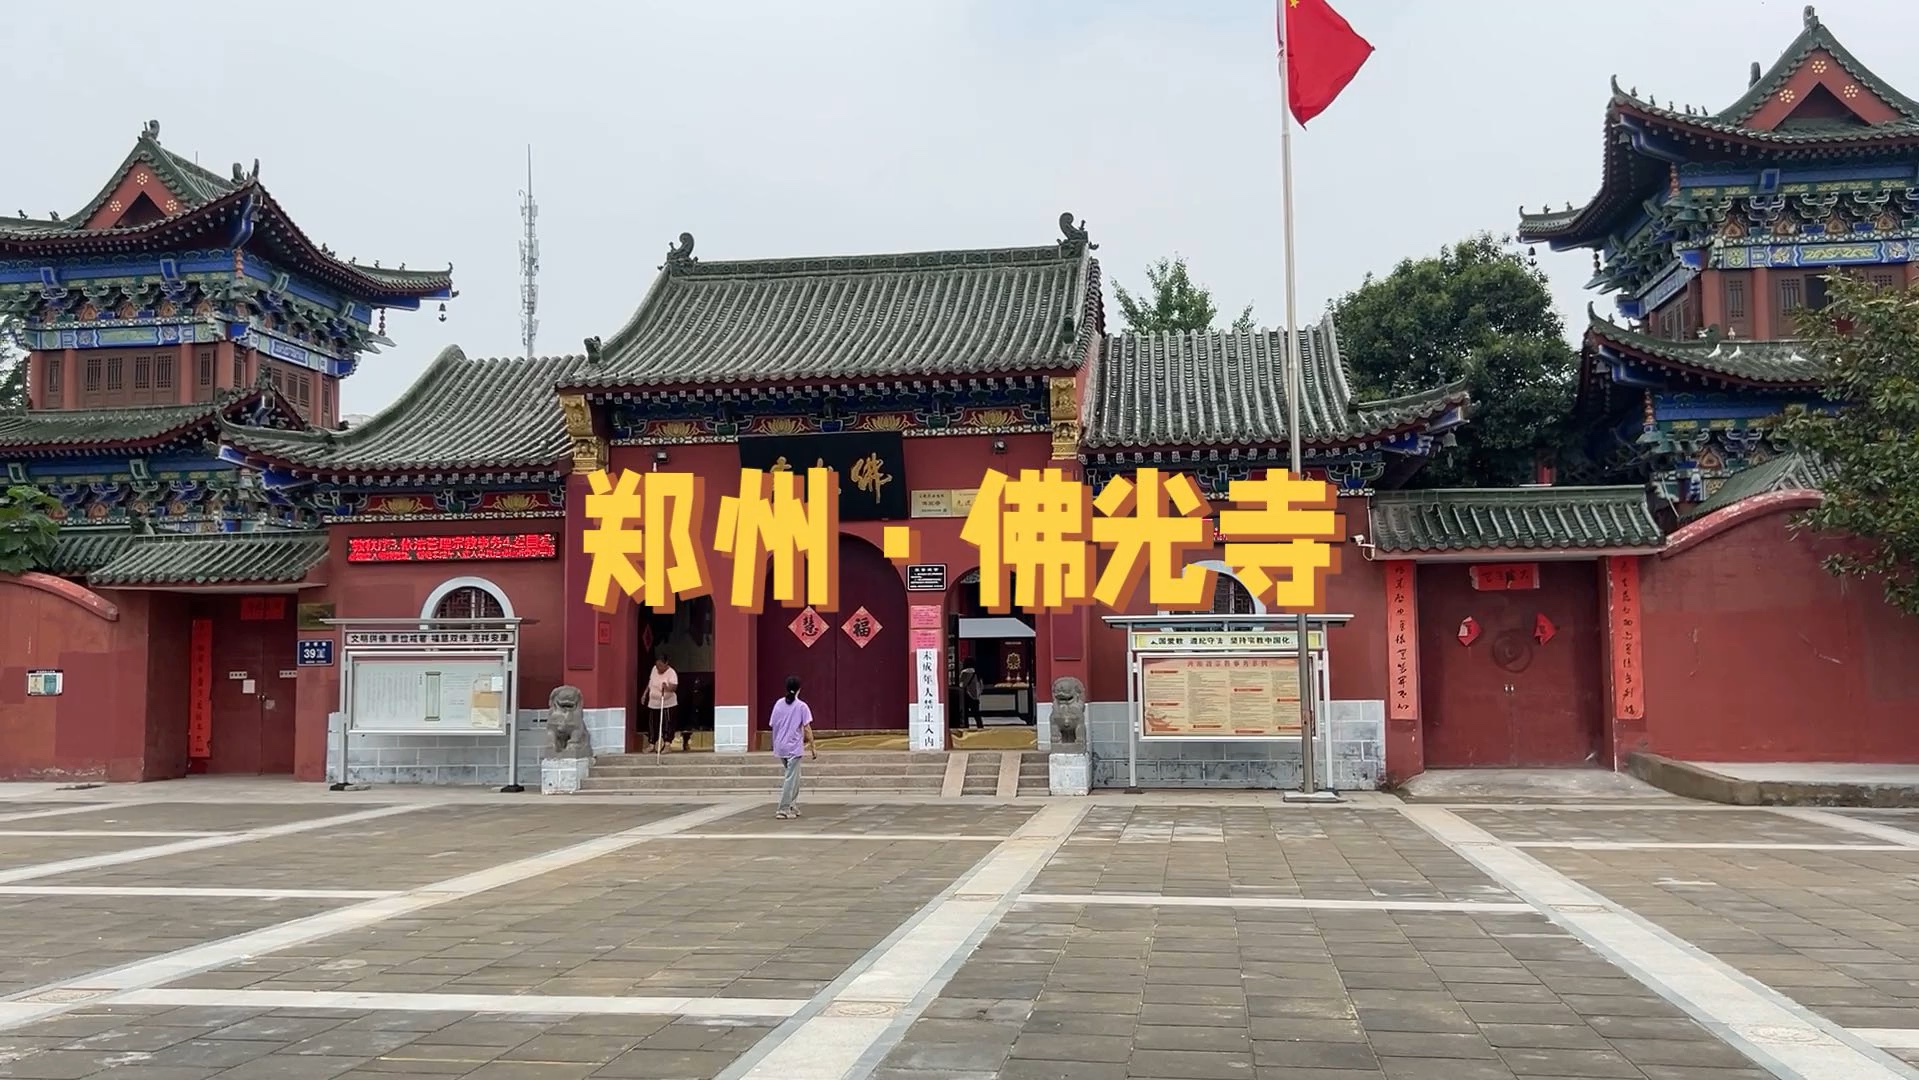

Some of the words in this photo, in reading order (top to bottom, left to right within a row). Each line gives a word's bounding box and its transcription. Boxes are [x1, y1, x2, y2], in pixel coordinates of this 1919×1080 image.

[801, 614, 820, 637] 慧
[852, 616, 872, 638] 福
[921, 650, 935, 747] 未成年人禁止入内
